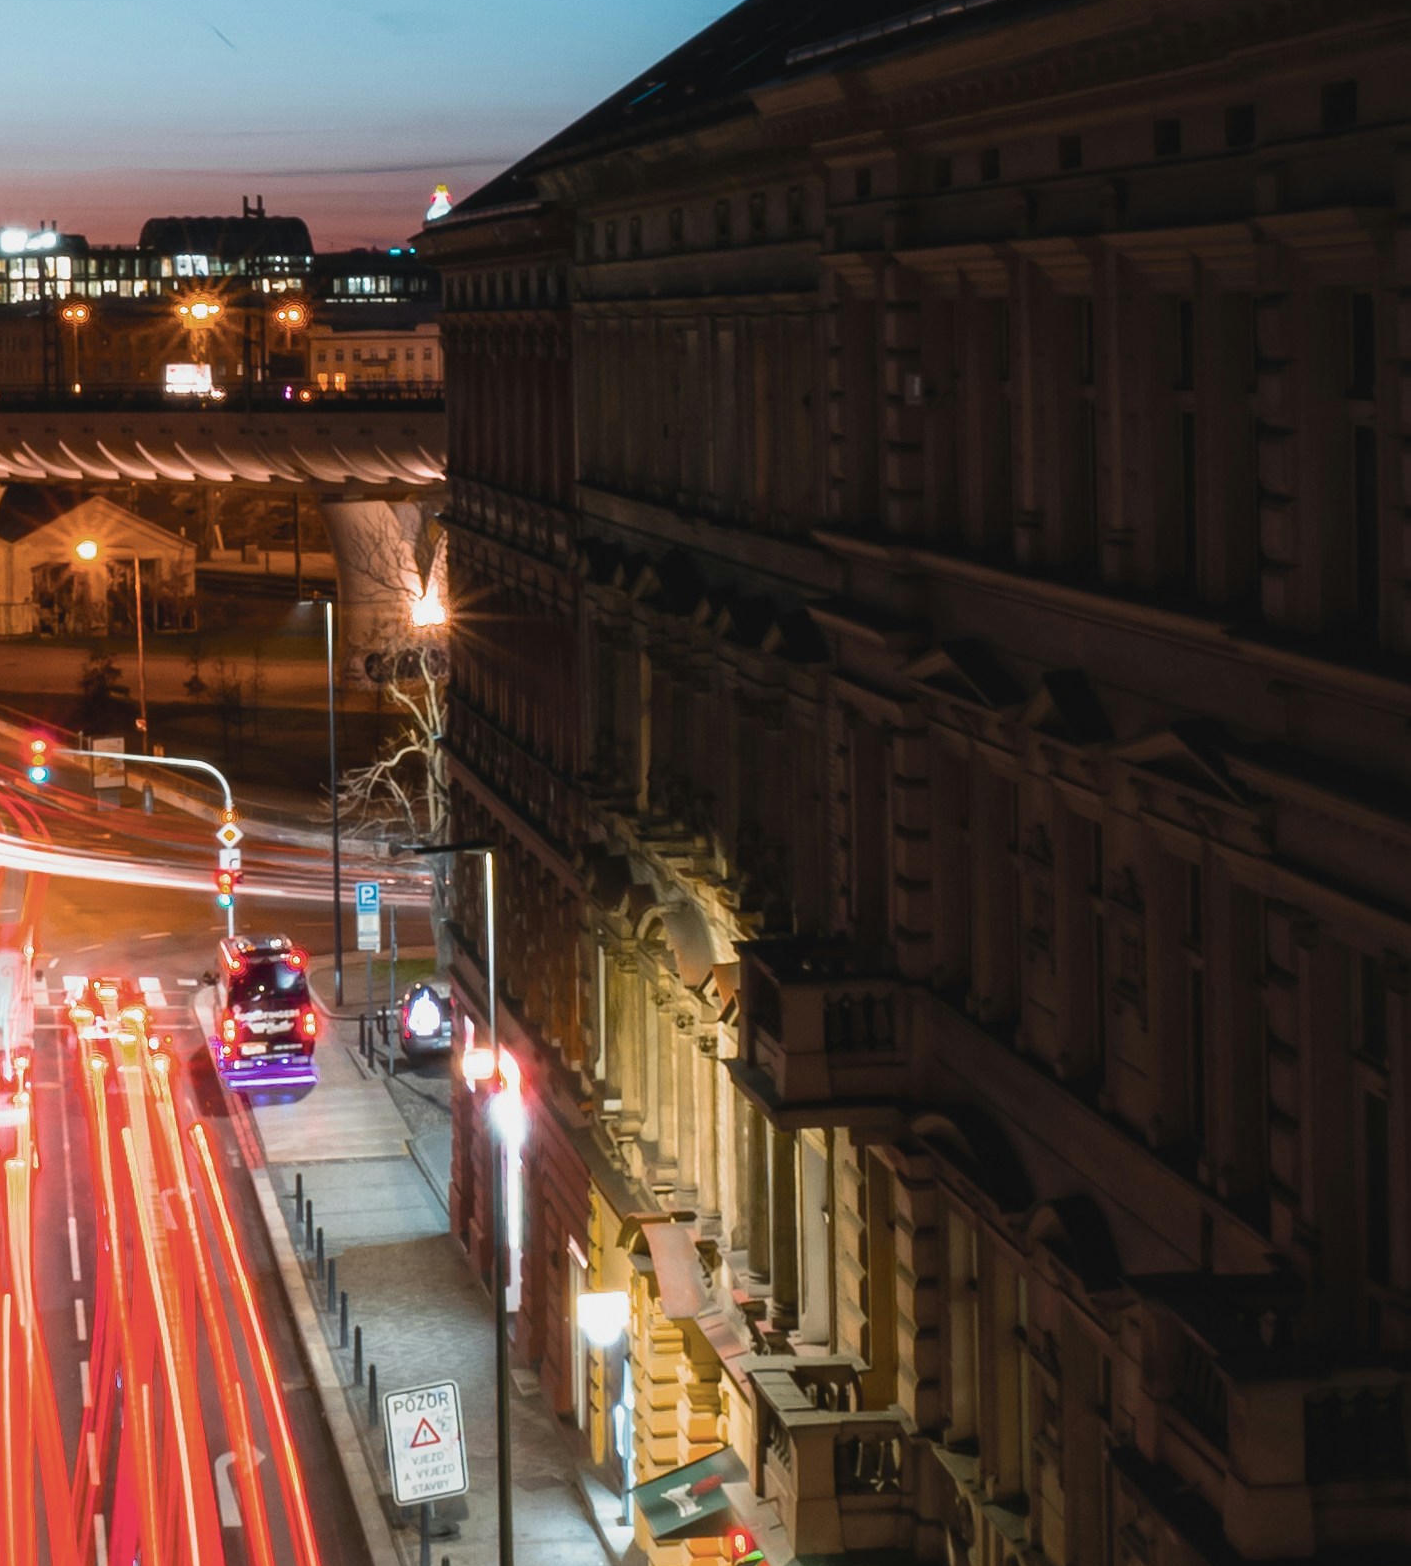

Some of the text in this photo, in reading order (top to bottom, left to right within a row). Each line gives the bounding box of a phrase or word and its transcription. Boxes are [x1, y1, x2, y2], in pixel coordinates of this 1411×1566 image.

[393, 1392, 449, 1415] POZOR
[411, 1451, 445, 1466] VJEZD
[410, 1480, 450, 1495] STAVBY
